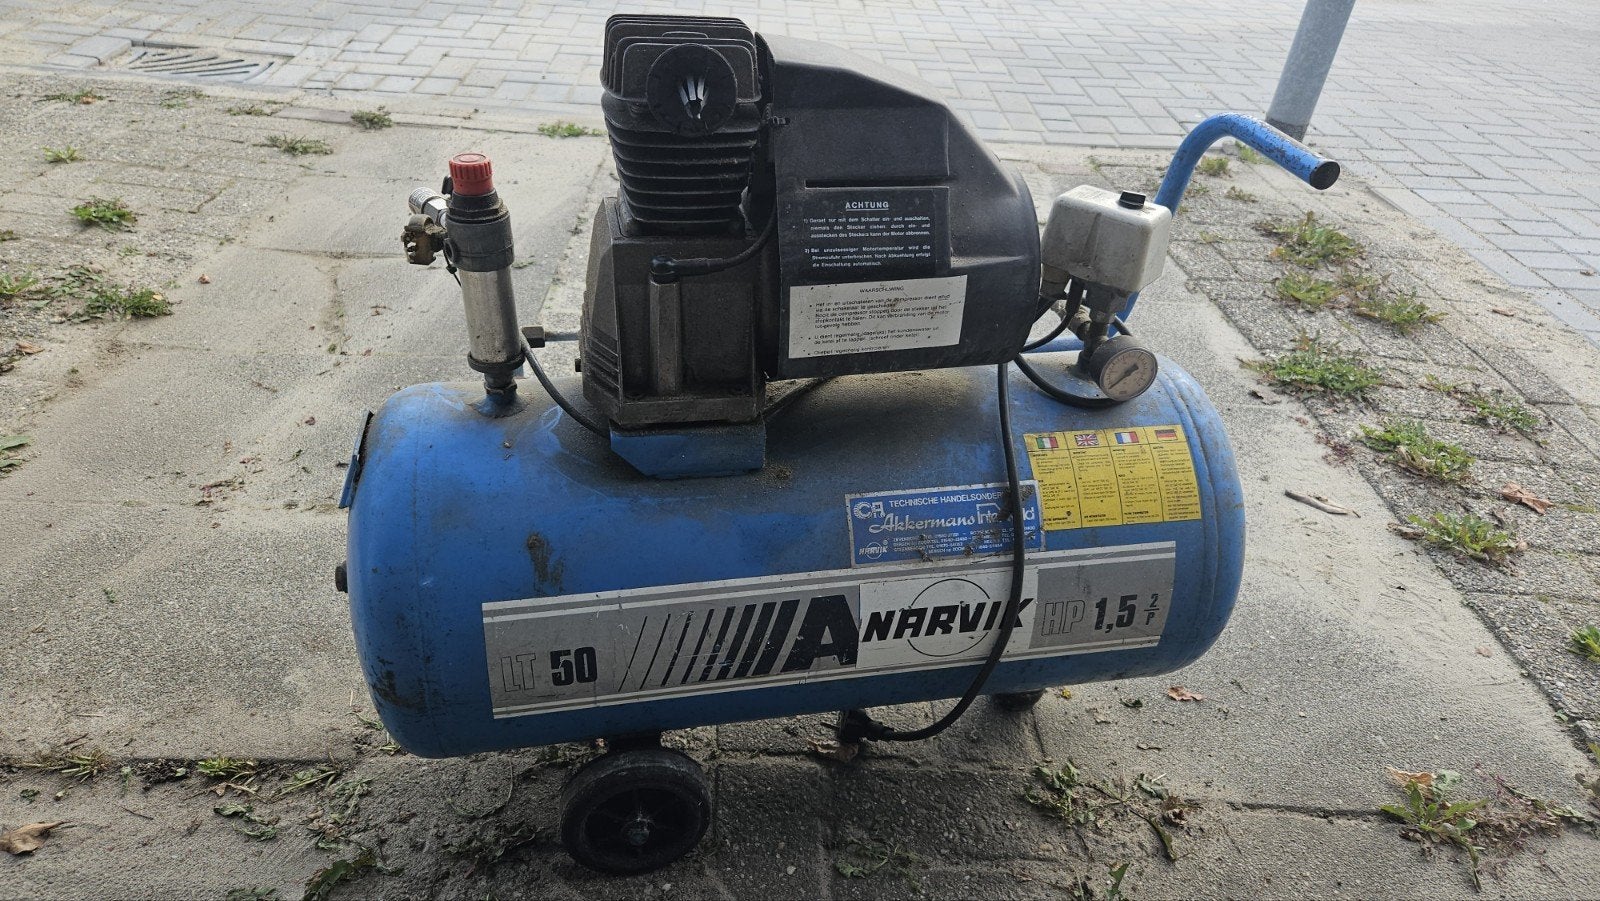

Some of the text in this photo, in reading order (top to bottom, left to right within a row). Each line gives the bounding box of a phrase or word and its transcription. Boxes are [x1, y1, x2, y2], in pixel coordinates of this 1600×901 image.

[845, 201, 890, 209] ACHTUNG
[888, 496, 938, 508] TECHNISCHE
[868, 512, 976, 534] Akkermans
[862, 598, 1034, 642] NARVIK
[1041, 594, 1138, 636] HP 1,5
[500, 646, 598, 692] LT 50
